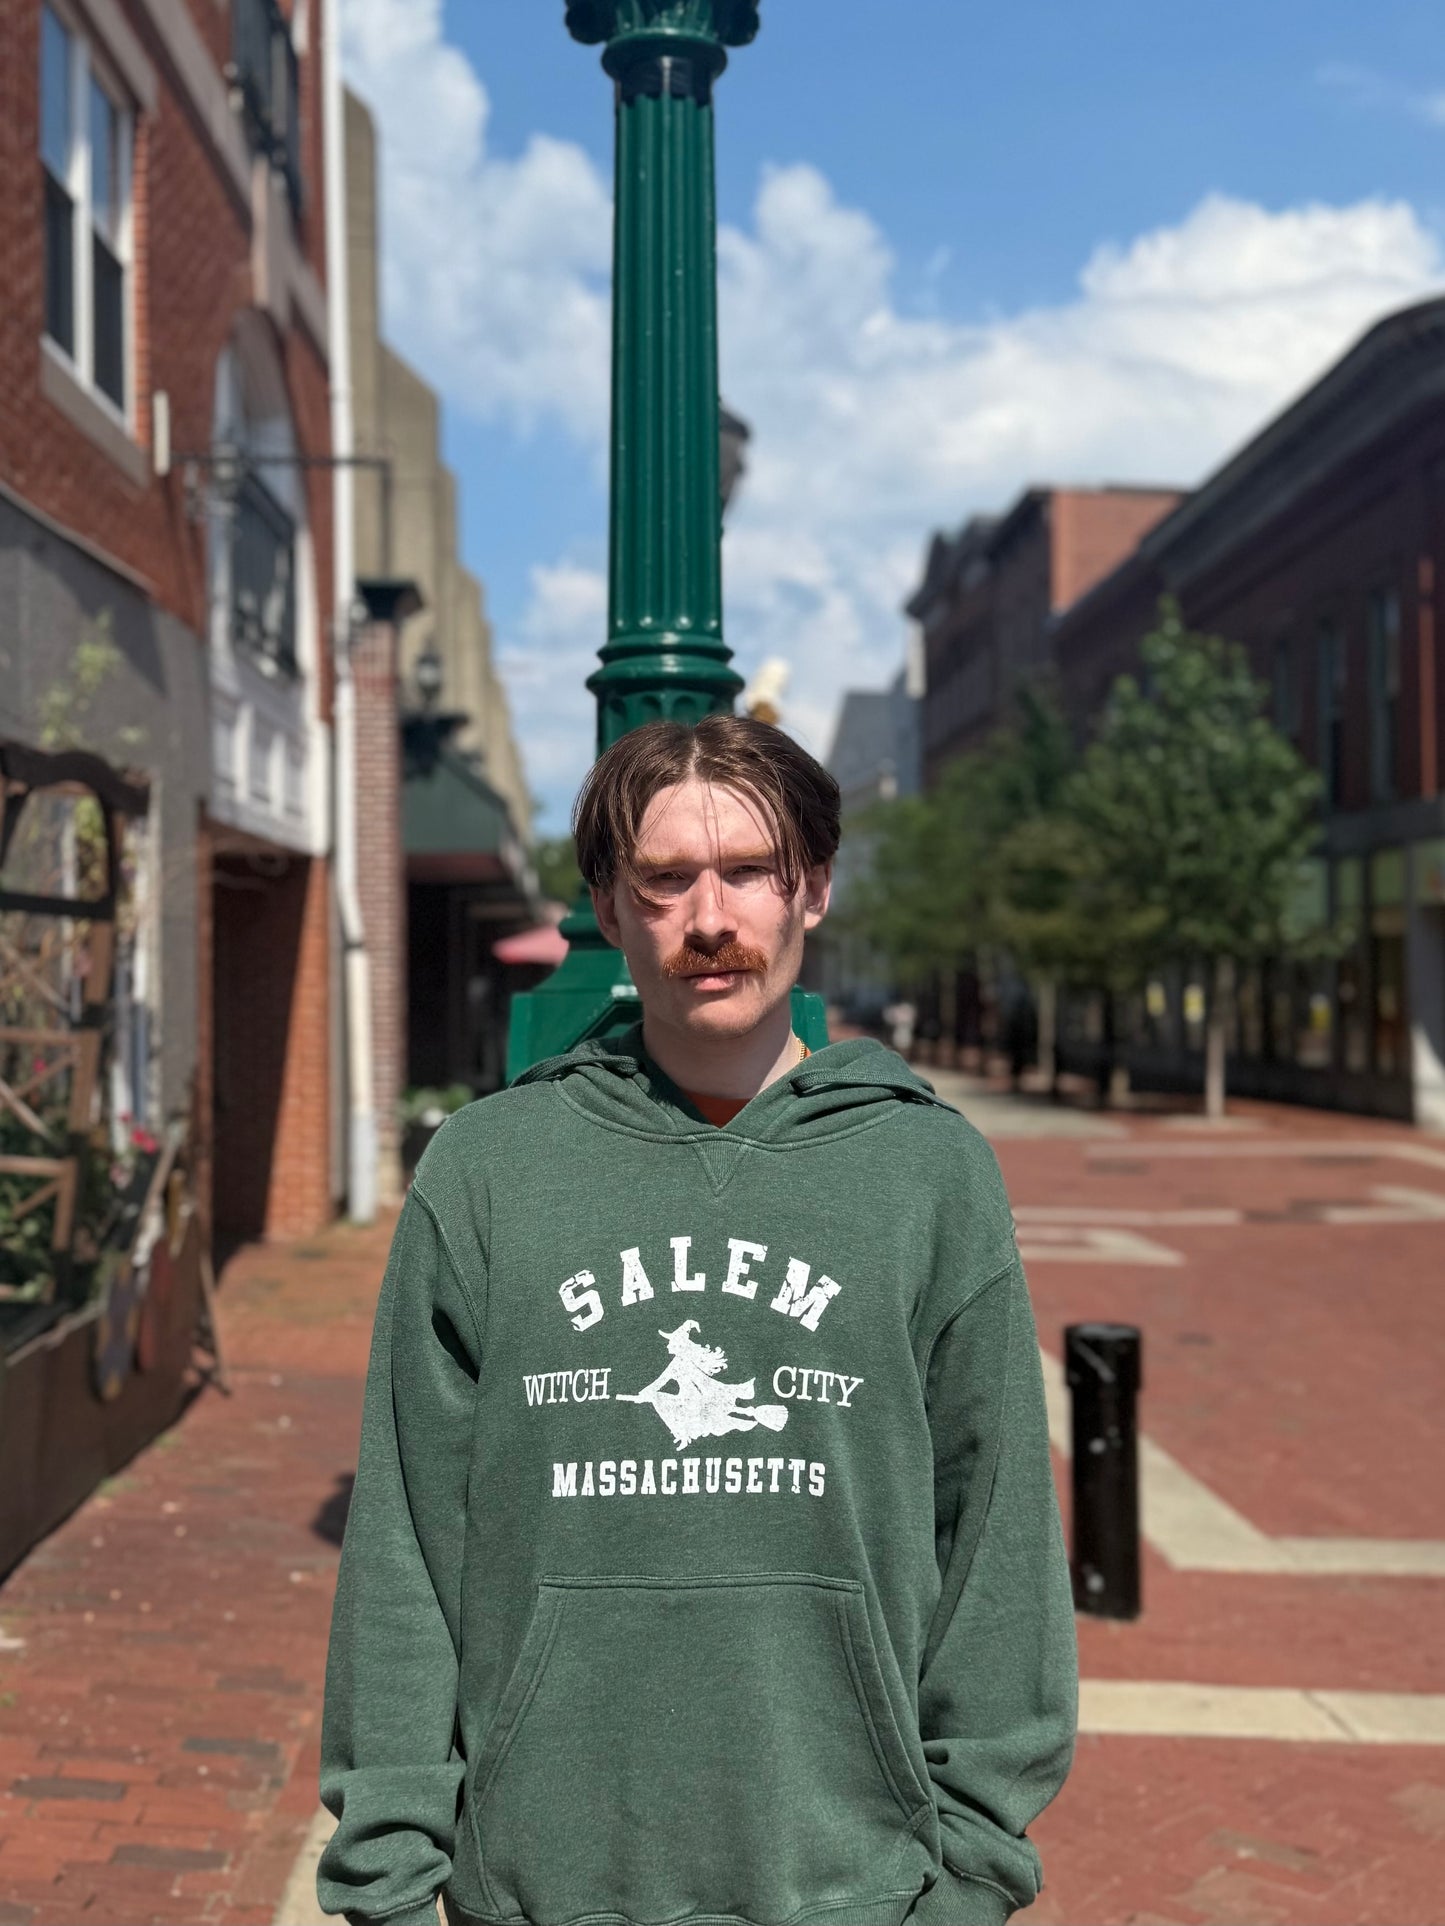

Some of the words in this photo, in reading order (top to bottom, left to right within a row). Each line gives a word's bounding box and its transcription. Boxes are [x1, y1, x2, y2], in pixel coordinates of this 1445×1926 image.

[558, 1236, 842, 1332] SALEM
[523, 1368, 612, 1407] WITCH
[772, 1366, 864, 1408] CITY
[551, 1457, 826, 1498] MASSACHUSETTS
